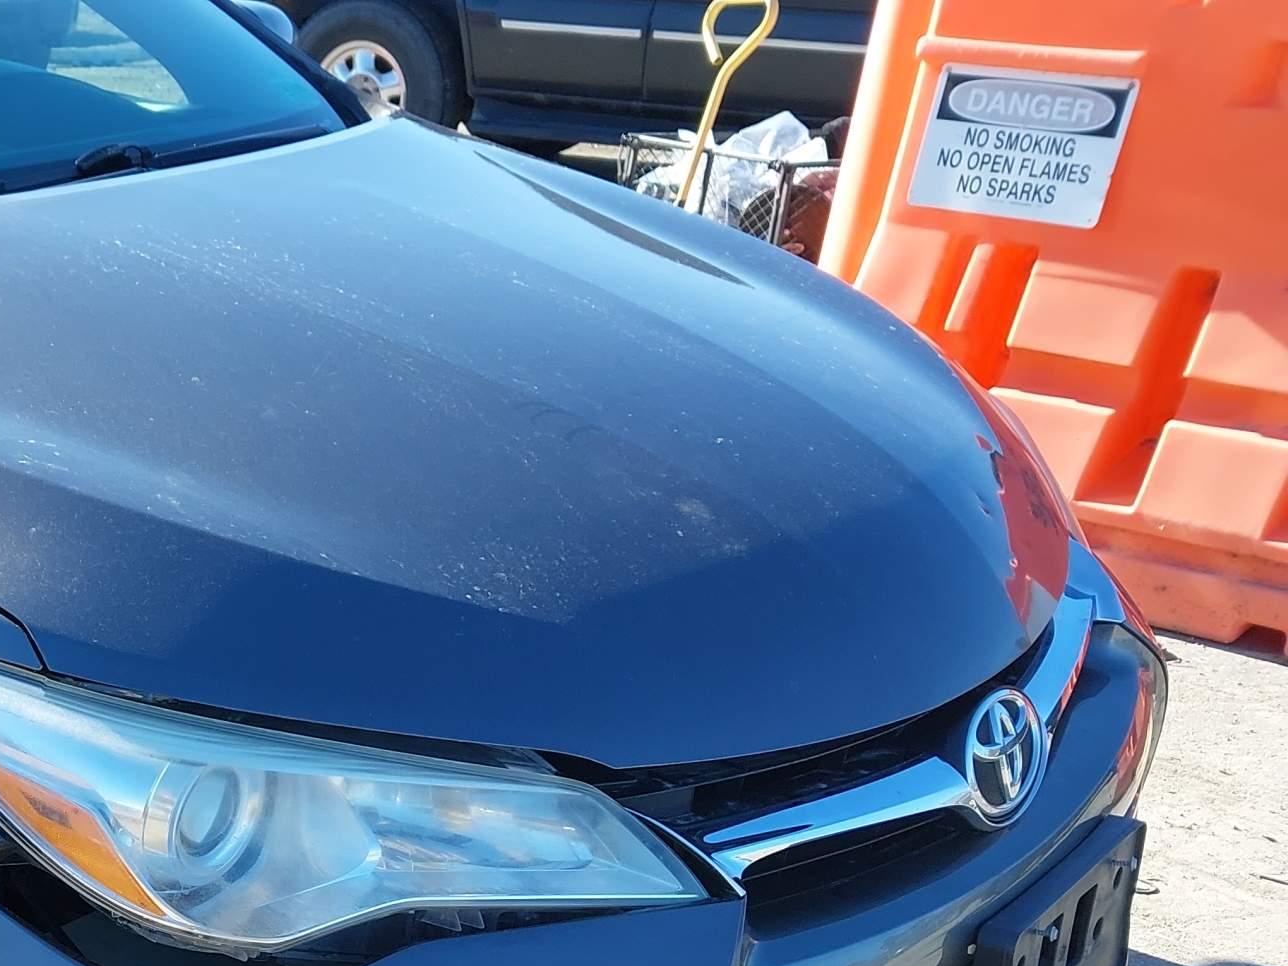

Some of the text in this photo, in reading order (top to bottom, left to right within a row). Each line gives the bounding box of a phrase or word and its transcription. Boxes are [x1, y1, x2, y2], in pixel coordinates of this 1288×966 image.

[967, 87, 1095, 124] DANGER
[964, 127, 1076, 157] NO SMOKING
[937, 148, 1091, 185] NO OPEN FLAMES
[956, 174, 982, 195] NO
[986, 179, 1057, 204] SPARKS
